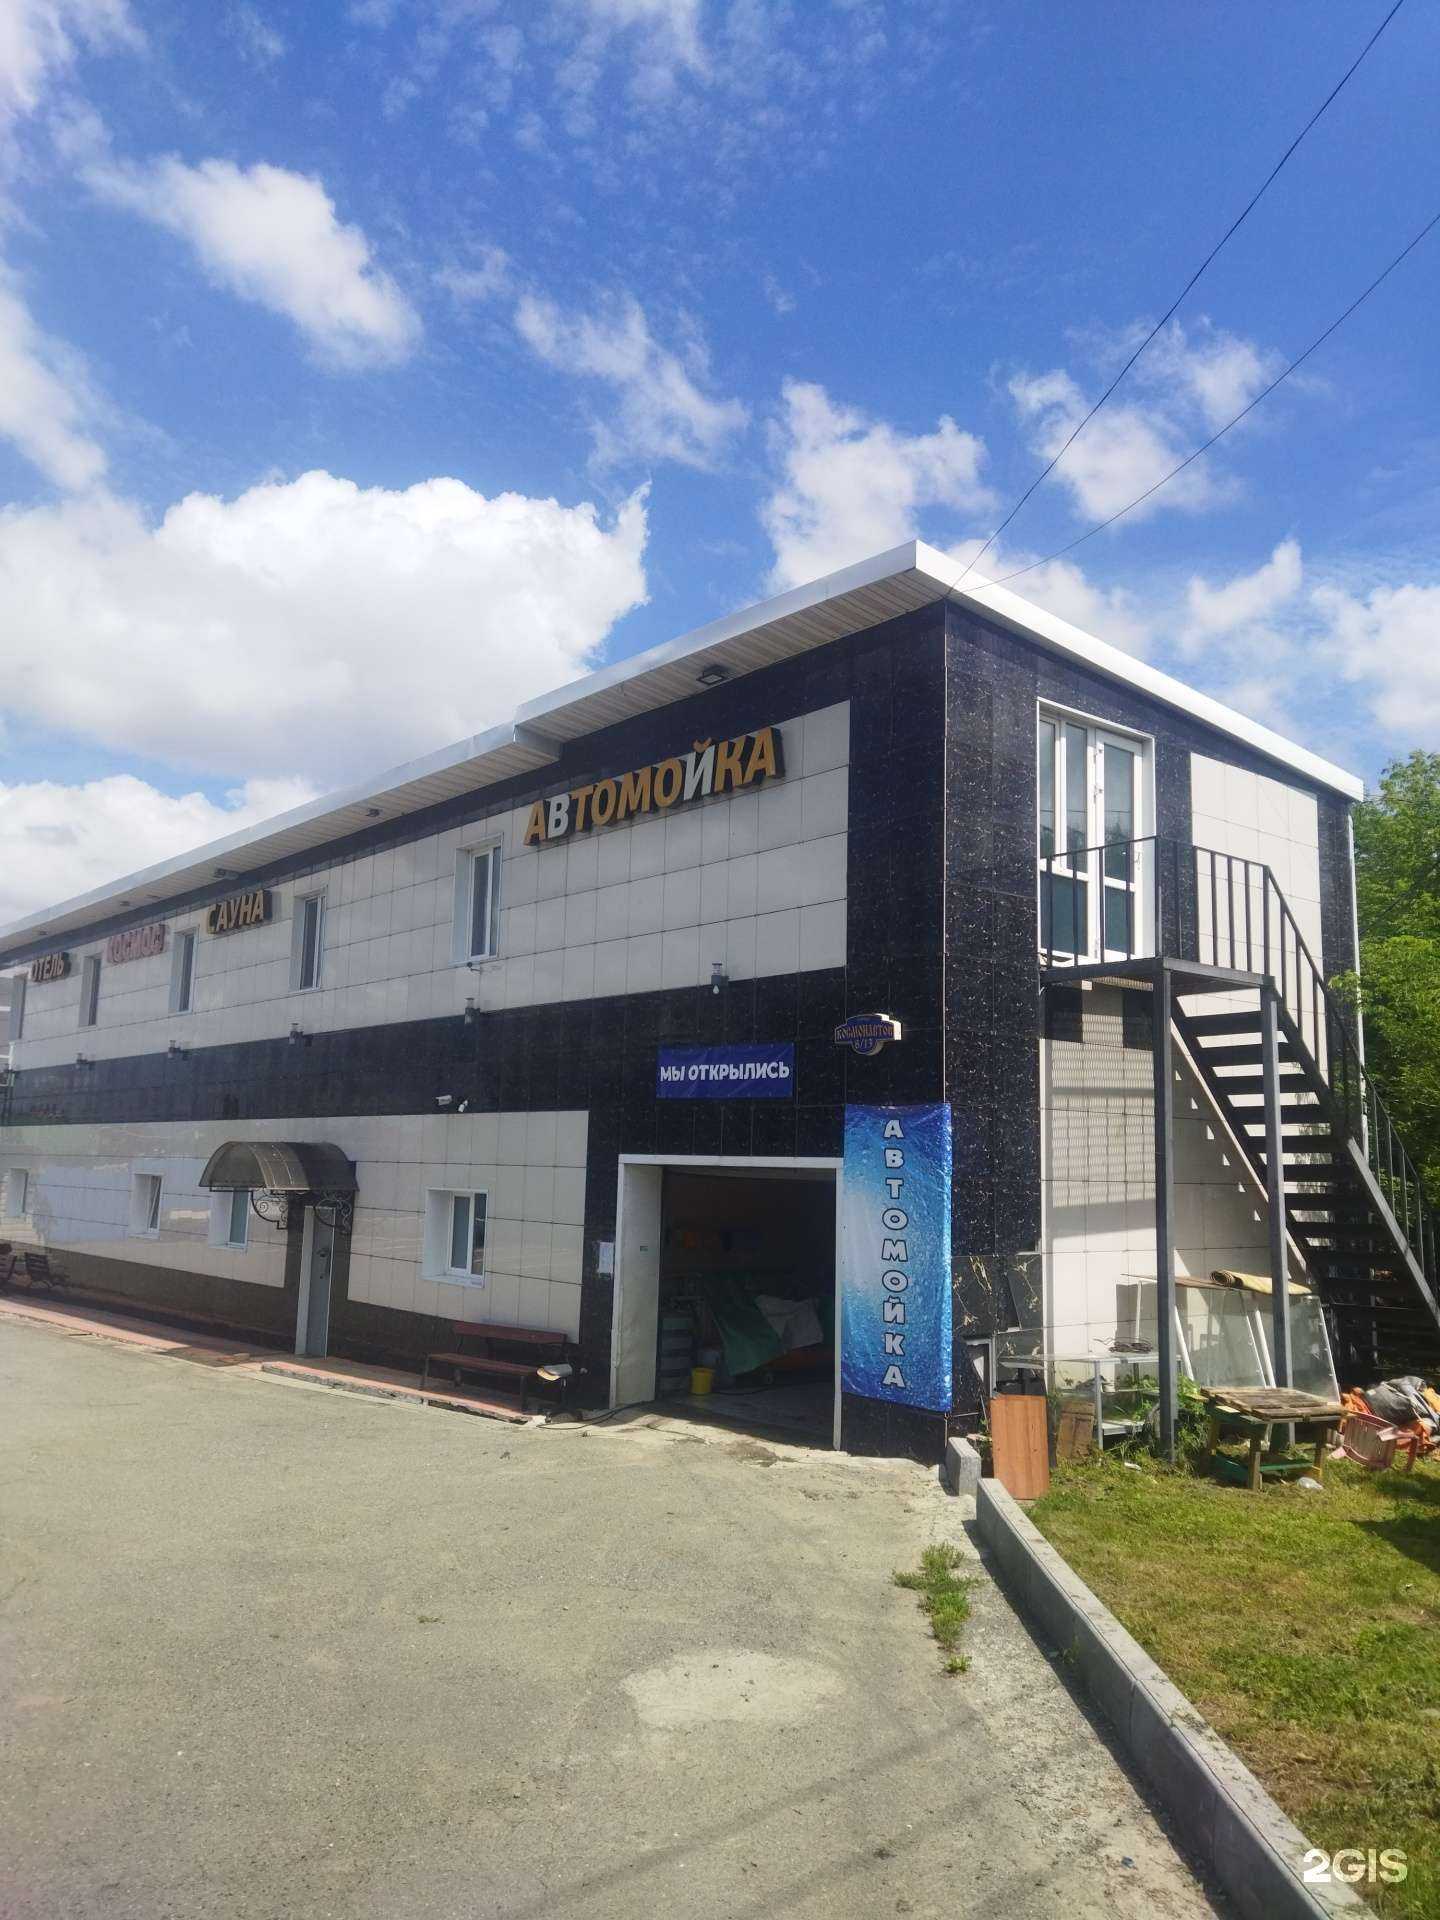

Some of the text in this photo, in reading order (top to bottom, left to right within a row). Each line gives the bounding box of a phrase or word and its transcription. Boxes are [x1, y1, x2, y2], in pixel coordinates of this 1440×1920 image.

[523, 726, 776, 846] АВТОМОЙКА
[207, 889, 265, 934] САУНА
[31, 951, 65, 982] ОТЕЛЬ
[660, 1061, 790, 1081] МЫ ОТКРЫЛИСЬ
[881, 1119, 909, 1389] АВТОМОЙКА
